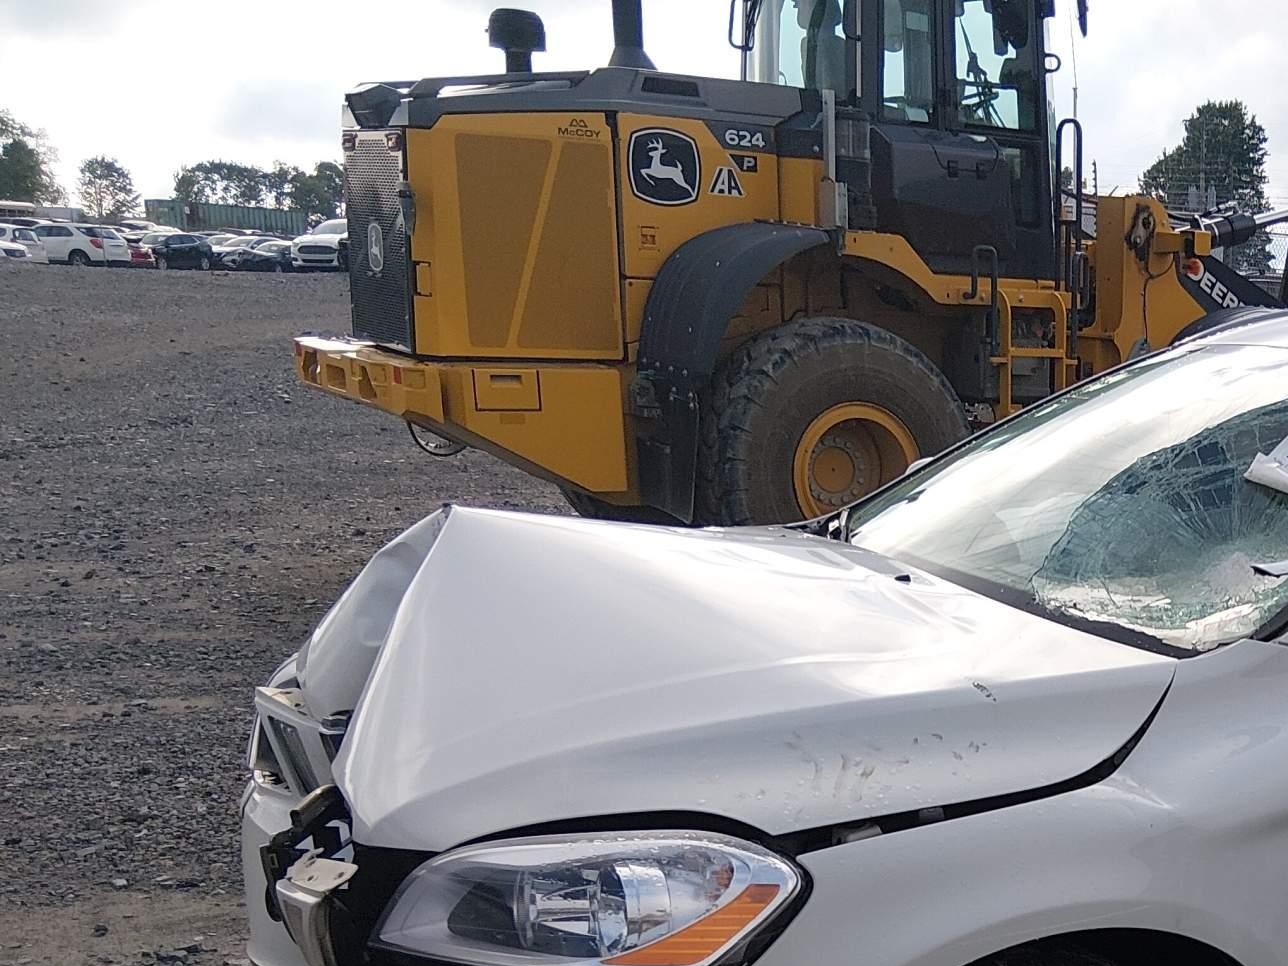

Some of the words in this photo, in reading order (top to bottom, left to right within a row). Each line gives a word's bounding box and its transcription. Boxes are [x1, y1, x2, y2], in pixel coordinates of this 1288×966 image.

[725, 129, 766, 148] 624
[743, 157, 756, 170] P
[1183, 257, 1246, 309] DEER
